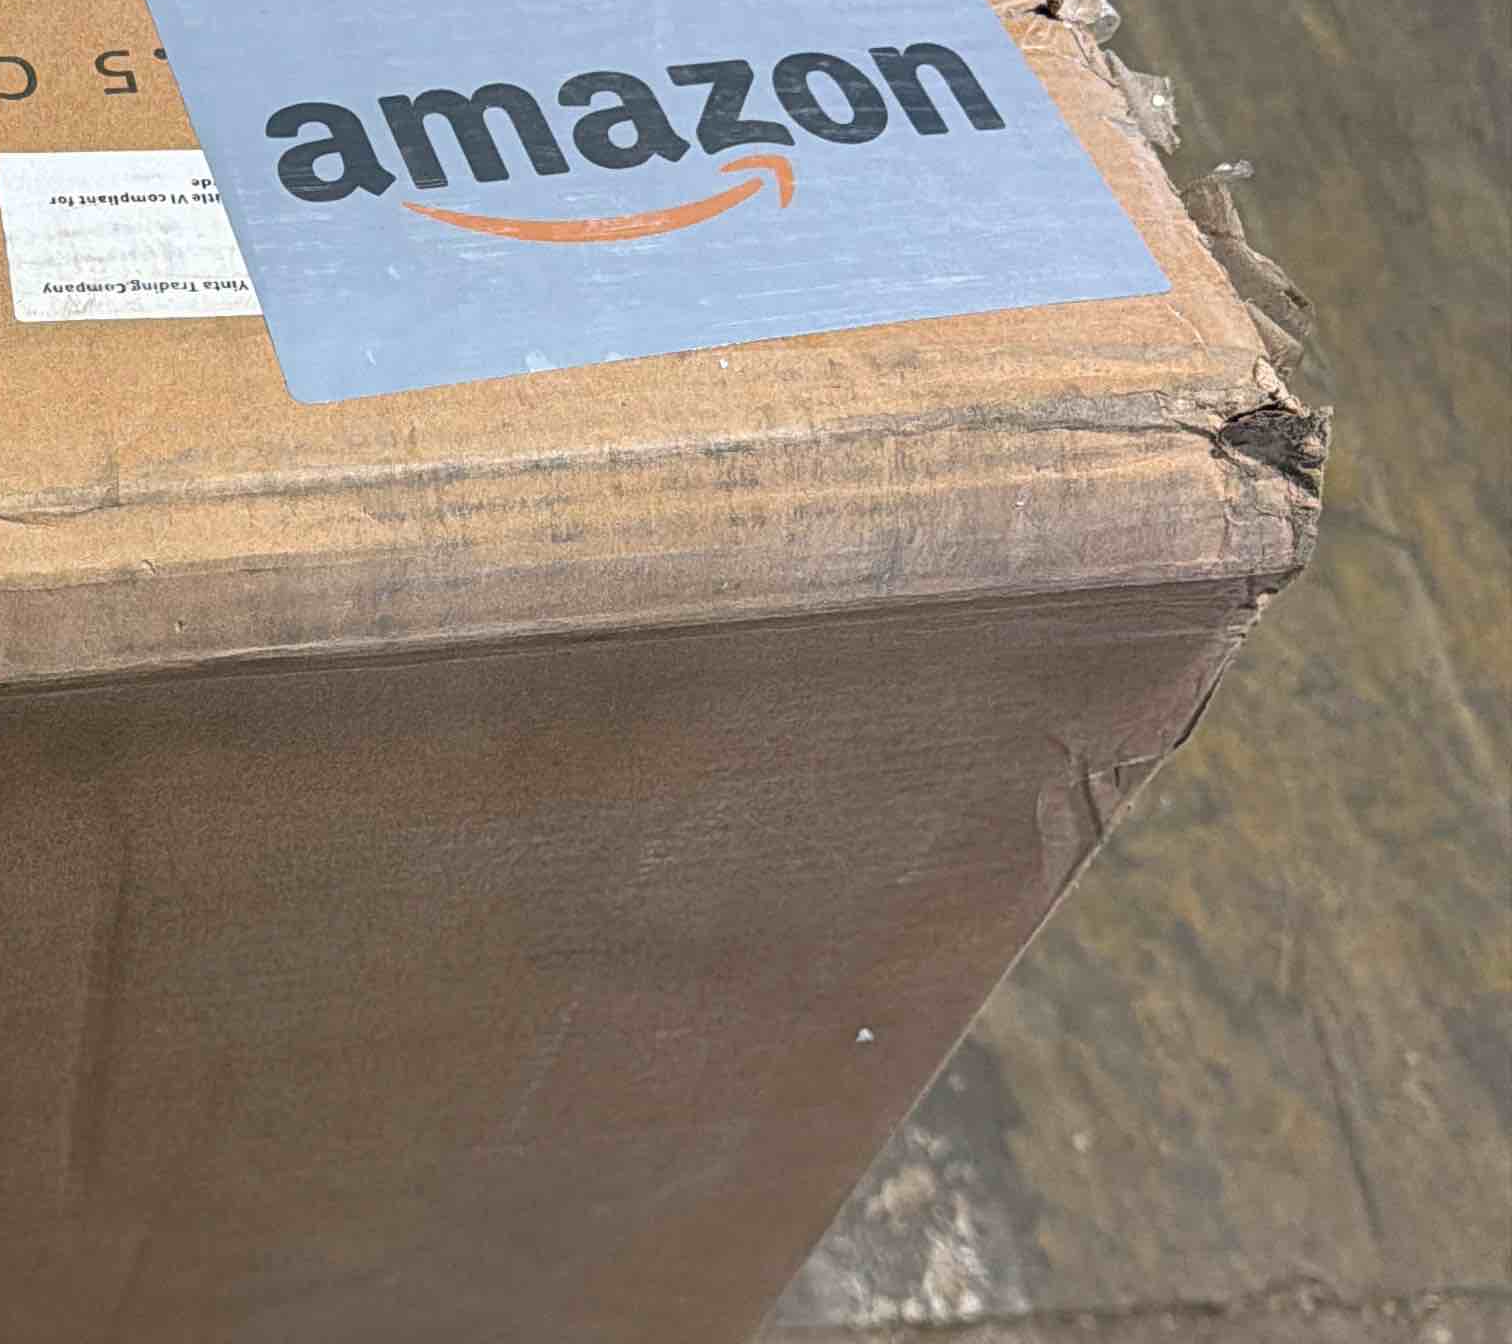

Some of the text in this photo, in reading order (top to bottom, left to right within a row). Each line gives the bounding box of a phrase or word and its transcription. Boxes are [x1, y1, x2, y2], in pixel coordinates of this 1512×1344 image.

[262, 39, 1006, 203] amazon
[191, 177, 217, 190] de
[48, 191, 222, 208] itle VI compliant for
[41, 279, 126, 296] Company
[202, 279, 249, 293] Yinta
